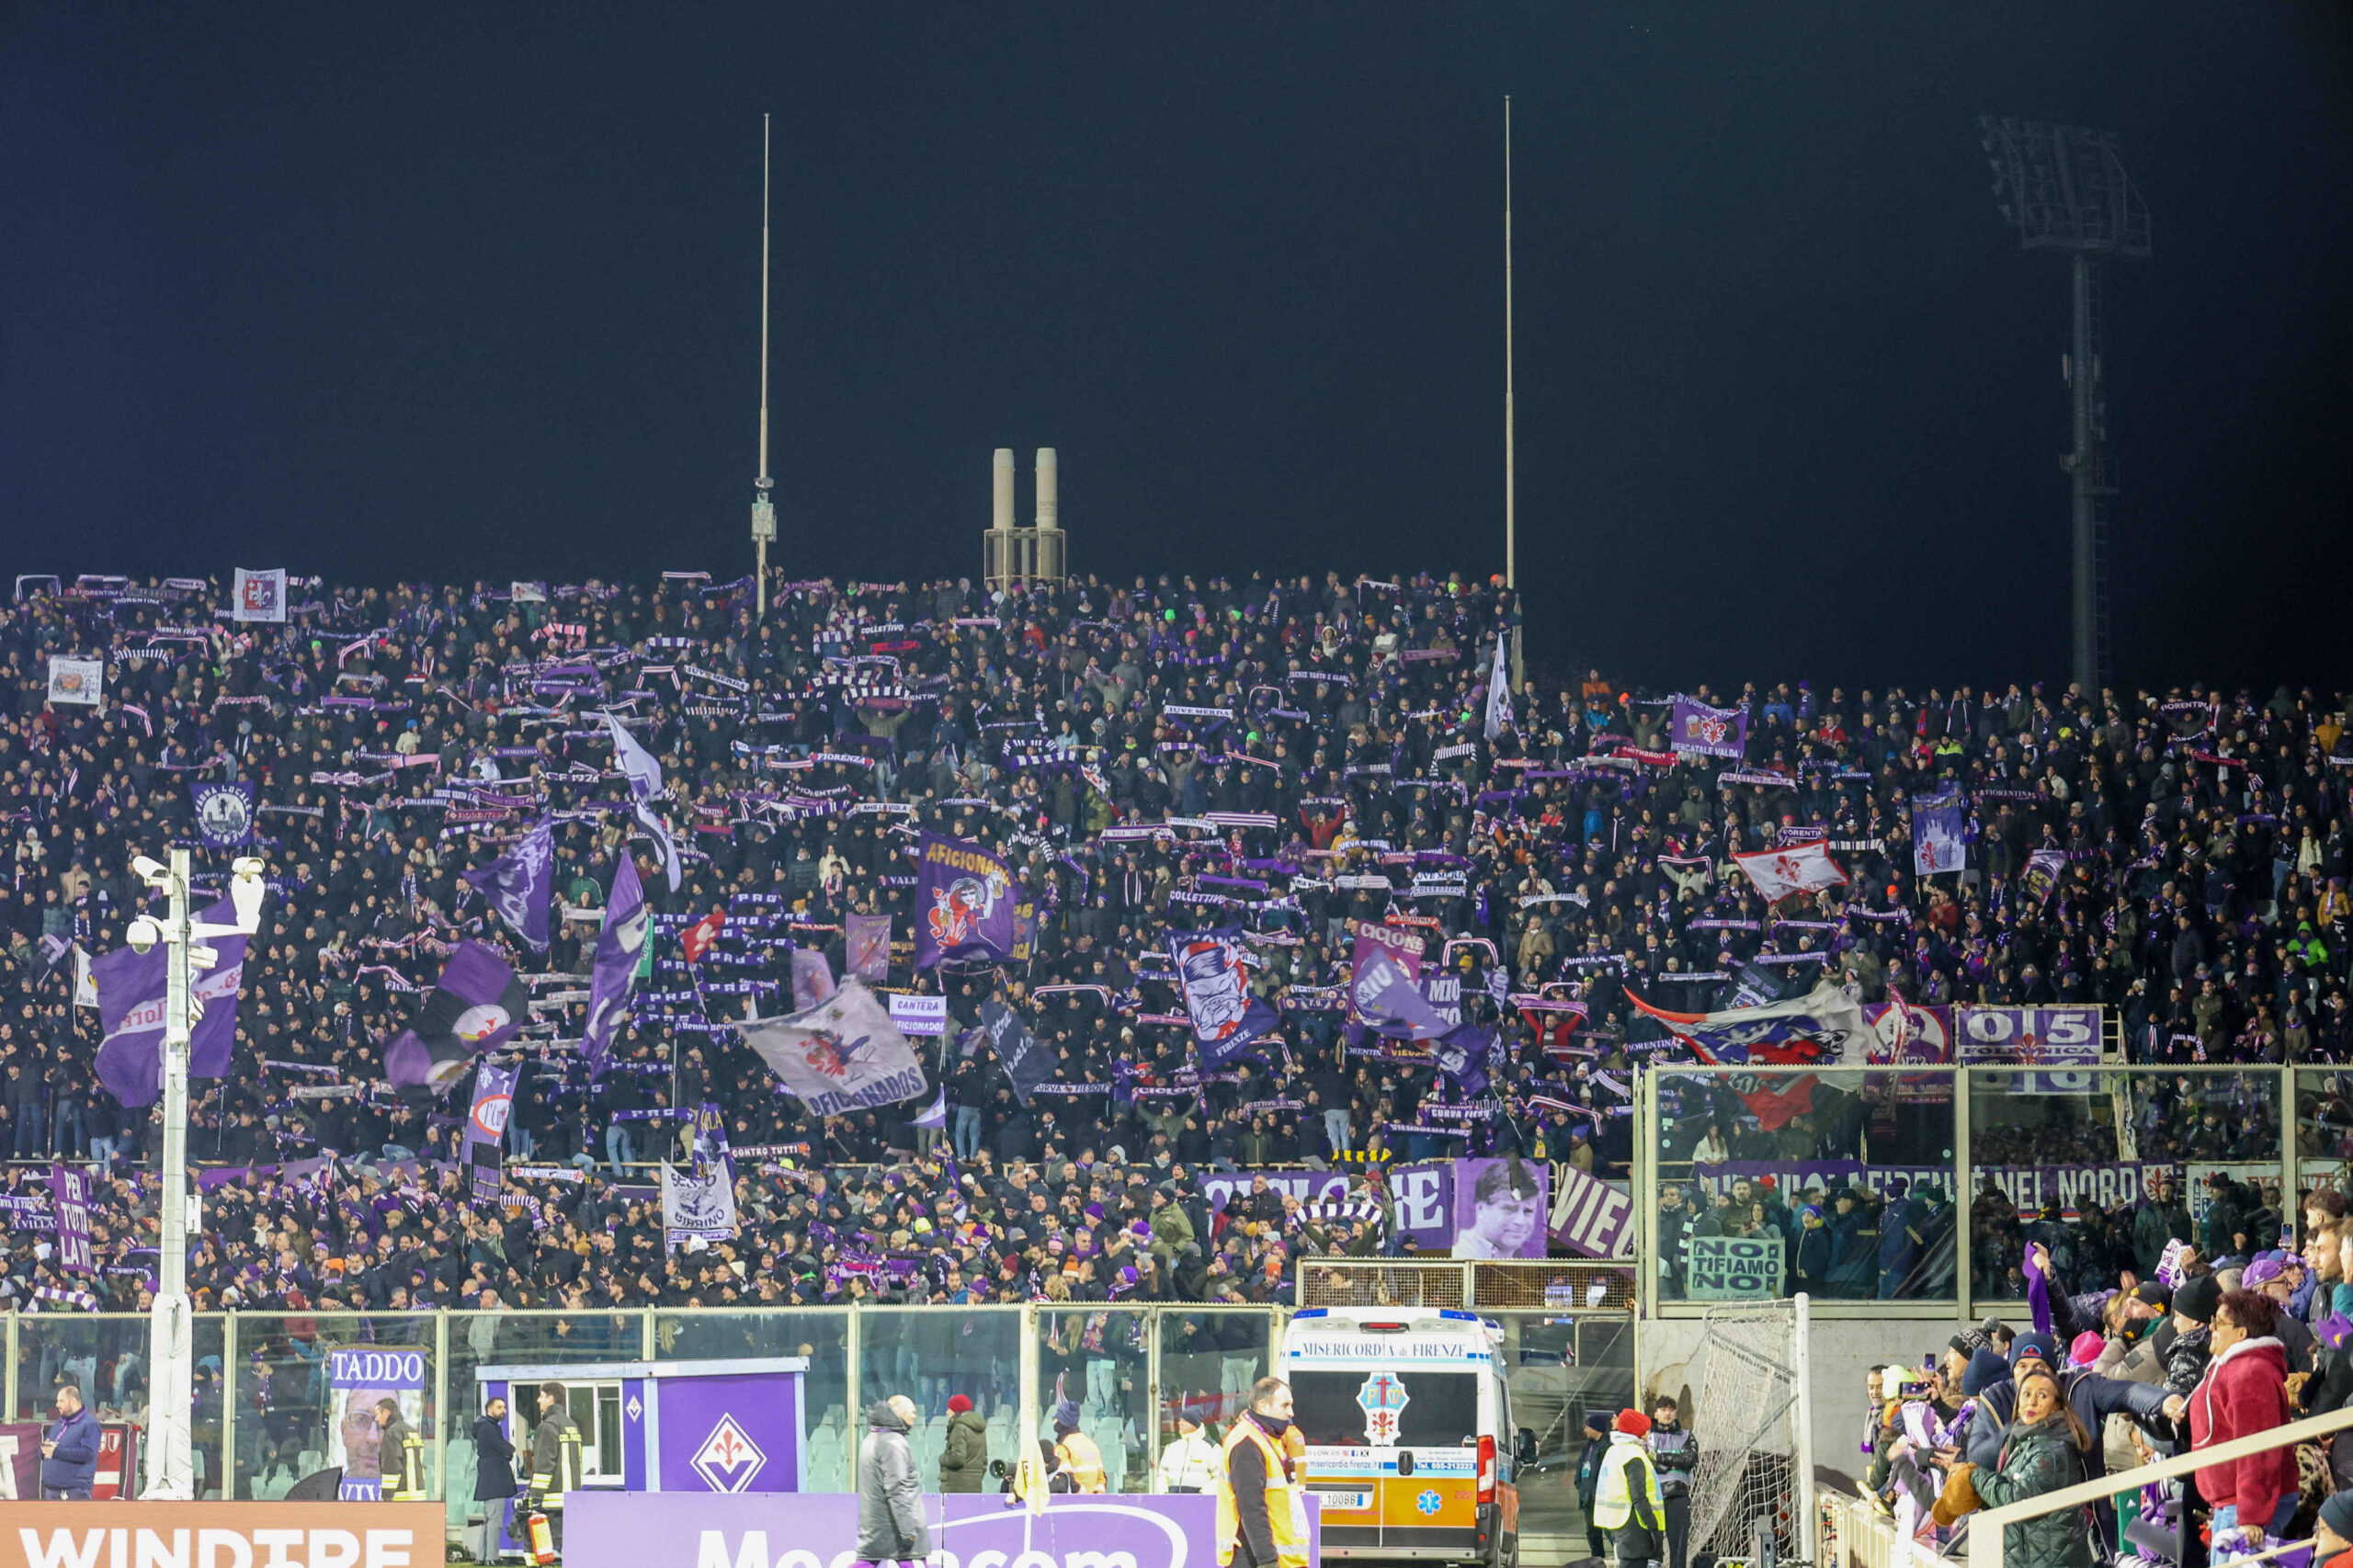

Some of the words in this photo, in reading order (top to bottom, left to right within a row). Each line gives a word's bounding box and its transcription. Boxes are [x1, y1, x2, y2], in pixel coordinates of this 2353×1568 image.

[861, 623, 904, 635] COLLETTIVO
[712, 674, 746, 691] MERDA
[1167, 706, 1194, 715] JUVE
[1196, 708, 1229, 717] MERDA
[1670, 741, 1714, 756] MERCATALE
[360, 752, 404, 762] FIORENTINA
[817, 752, 866, 765] FIORENZA
[538, 772, 568, 781] ACF
[195, 786, 217, 812] FAUNA
[222, 784, 253, 811] LOCALE
[796, 786, 847, 797] FIORENTINA
[1985, 789, 2032, 798] FIORENTINA
[1169, 890, 1225, 905] COLLETTIVO
[1413, 885, 1462, 895] COLLETTIVO
[1360, 923, 1424, 952] CICLONE
[1428, 977, 1461, 1003] MIO
[897, 999, 939, 1011] CANTERA
[1966, 1012, 2013, 1043] 0
[2046, 1013, 2091, 1044] 5
[1216, 1028, 1252, 1057] FIRENZE
[808, 1065, 923, 1116] AFICONADOS
[1431, 1109, 1461, 1119] CURVA
[732, 1147, 768, 1158] CONTRO
[771, 1145, 798, 1156] TUTTI
[63, 1170, 83, 1203] PER
[671, 1173, 717, 1189] SESO
[1995, 1170, 2045, 1210] NEL
[2057, 1166, 2139, 1210] NORD
[60, 1201, 89, 1236] TUTTA
[675, 1209, 725, 1228] BIRRINO
[61, 1236, 80, 1266] LA
[1693, 1257, 1779, 1276] TIFIAMO
[1302, 1342, 1395, 1357] MISERICORDIA
[1413, 1344, 1466, 1358] FIRENZE
[332, 1353, 423, 1382] TADDO
